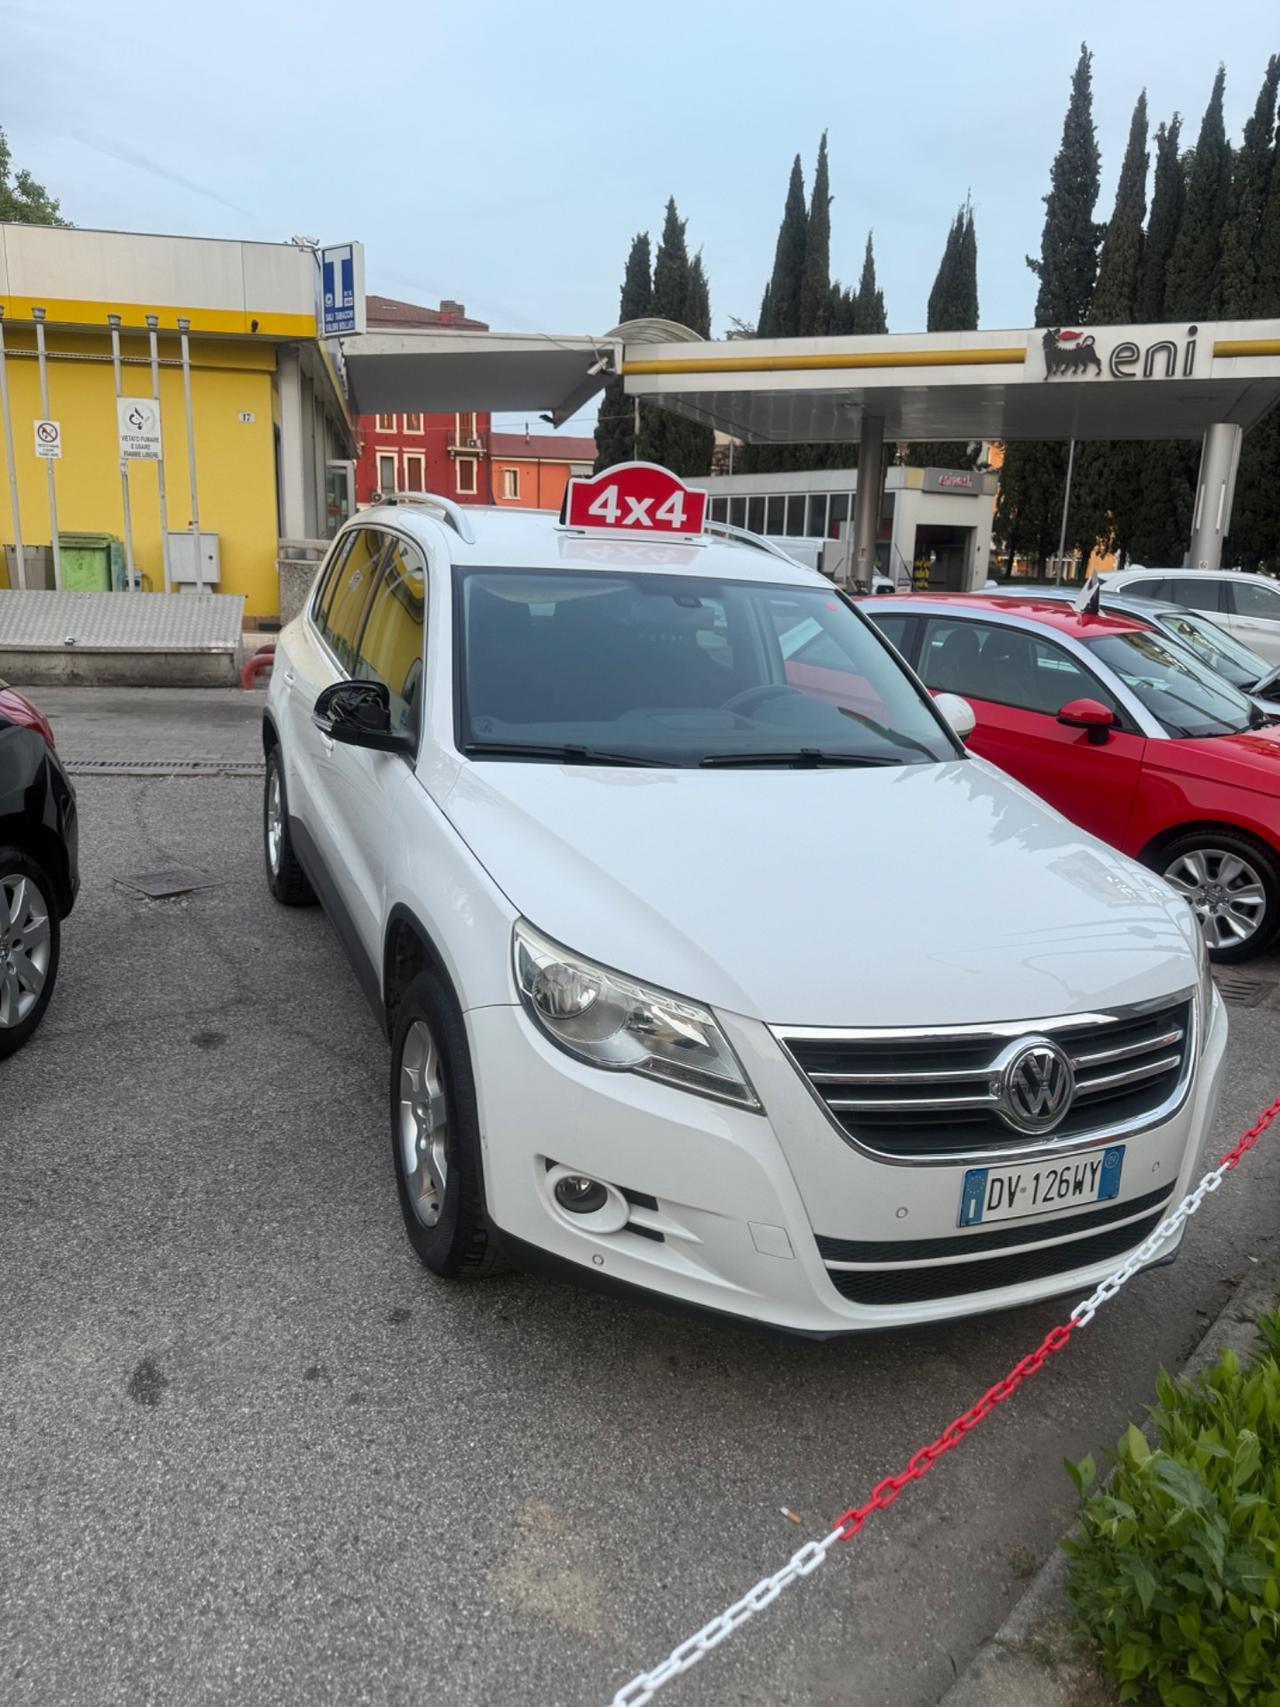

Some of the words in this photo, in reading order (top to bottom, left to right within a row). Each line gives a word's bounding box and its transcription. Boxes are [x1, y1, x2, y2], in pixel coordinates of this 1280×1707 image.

[324, 246, 351, 308] T
[1109, 325, 1198, 379] eni
[243, 413, 251, 422] 17
[588, 485, 687, 528] 4x4
[987, 1175, 1021, 1211] DV
[1032, 1160, 1102, 1205] 126WY
